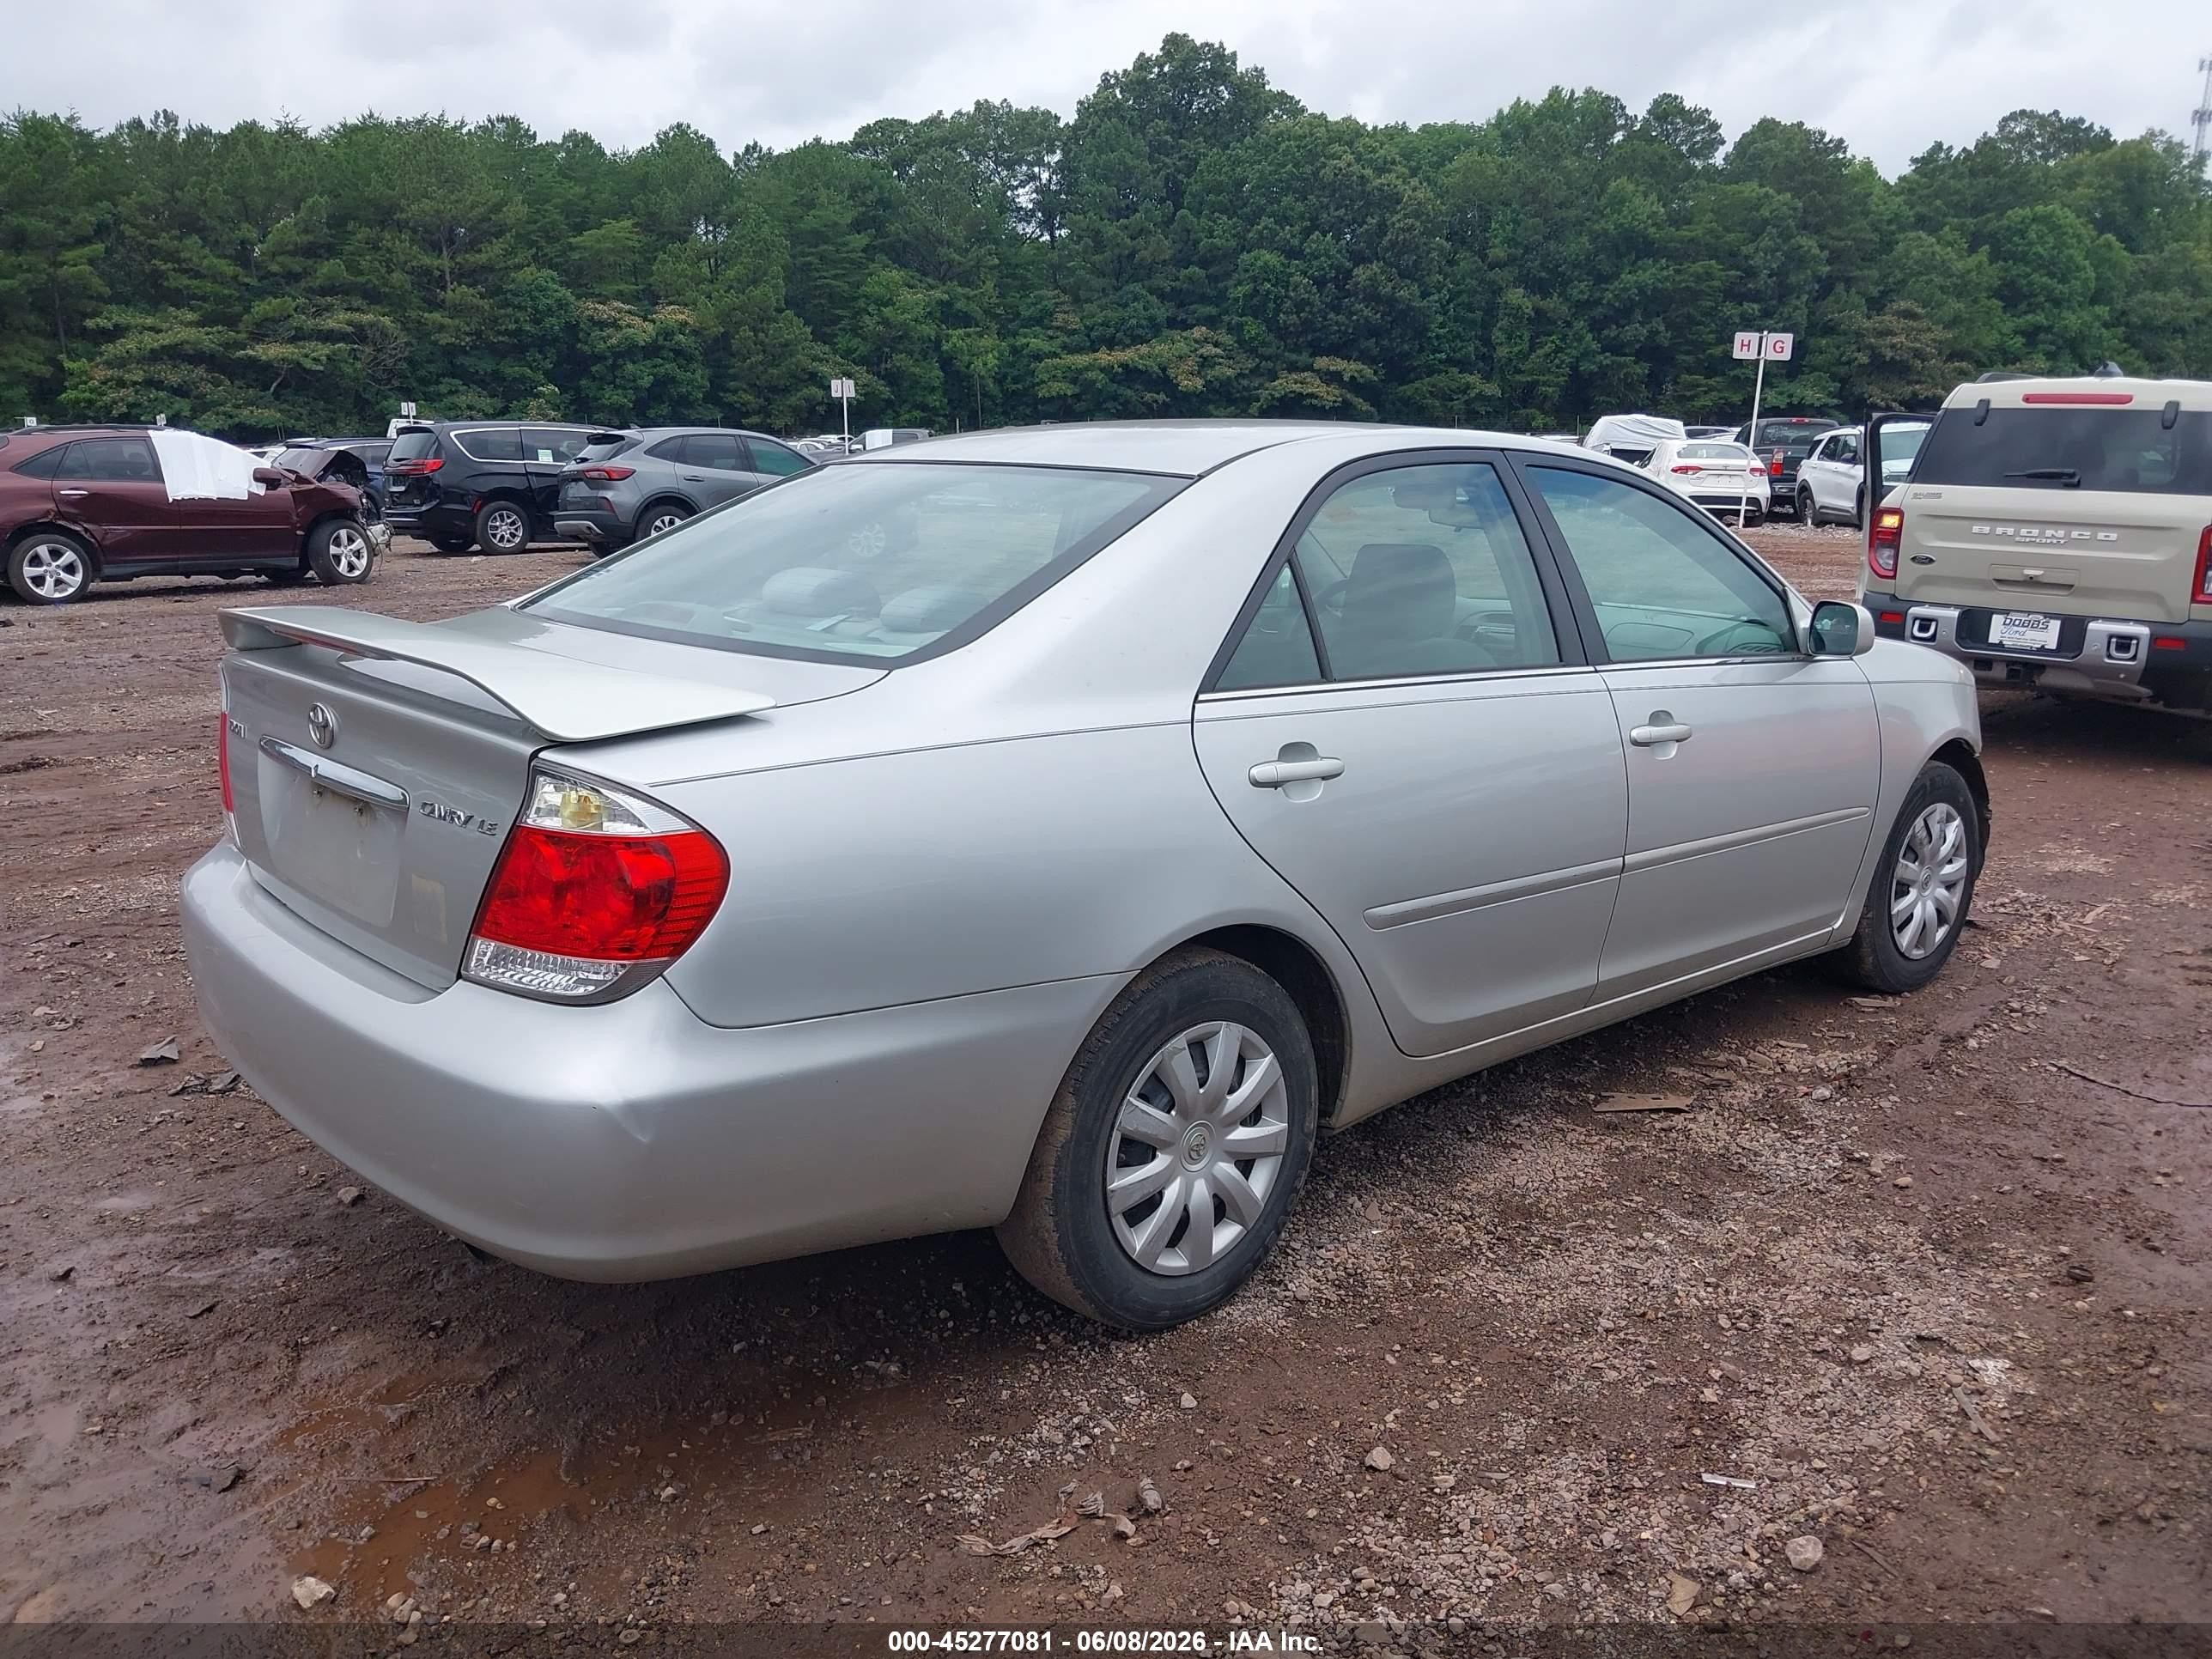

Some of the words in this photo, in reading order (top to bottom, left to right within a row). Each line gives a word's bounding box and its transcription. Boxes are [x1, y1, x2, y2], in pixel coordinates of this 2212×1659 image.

[1740, 338, 1752, 353] H
[1772, 339, 1785, 354] G
[1972, 526, 2118, 541] BRONCO
[2002, 617, 2051, 629] DOBBS
[2000, 625, 2027, 637] Ford
[419, 800, 474, 829] CAMRY
[477, 818, 499, 836] LE
